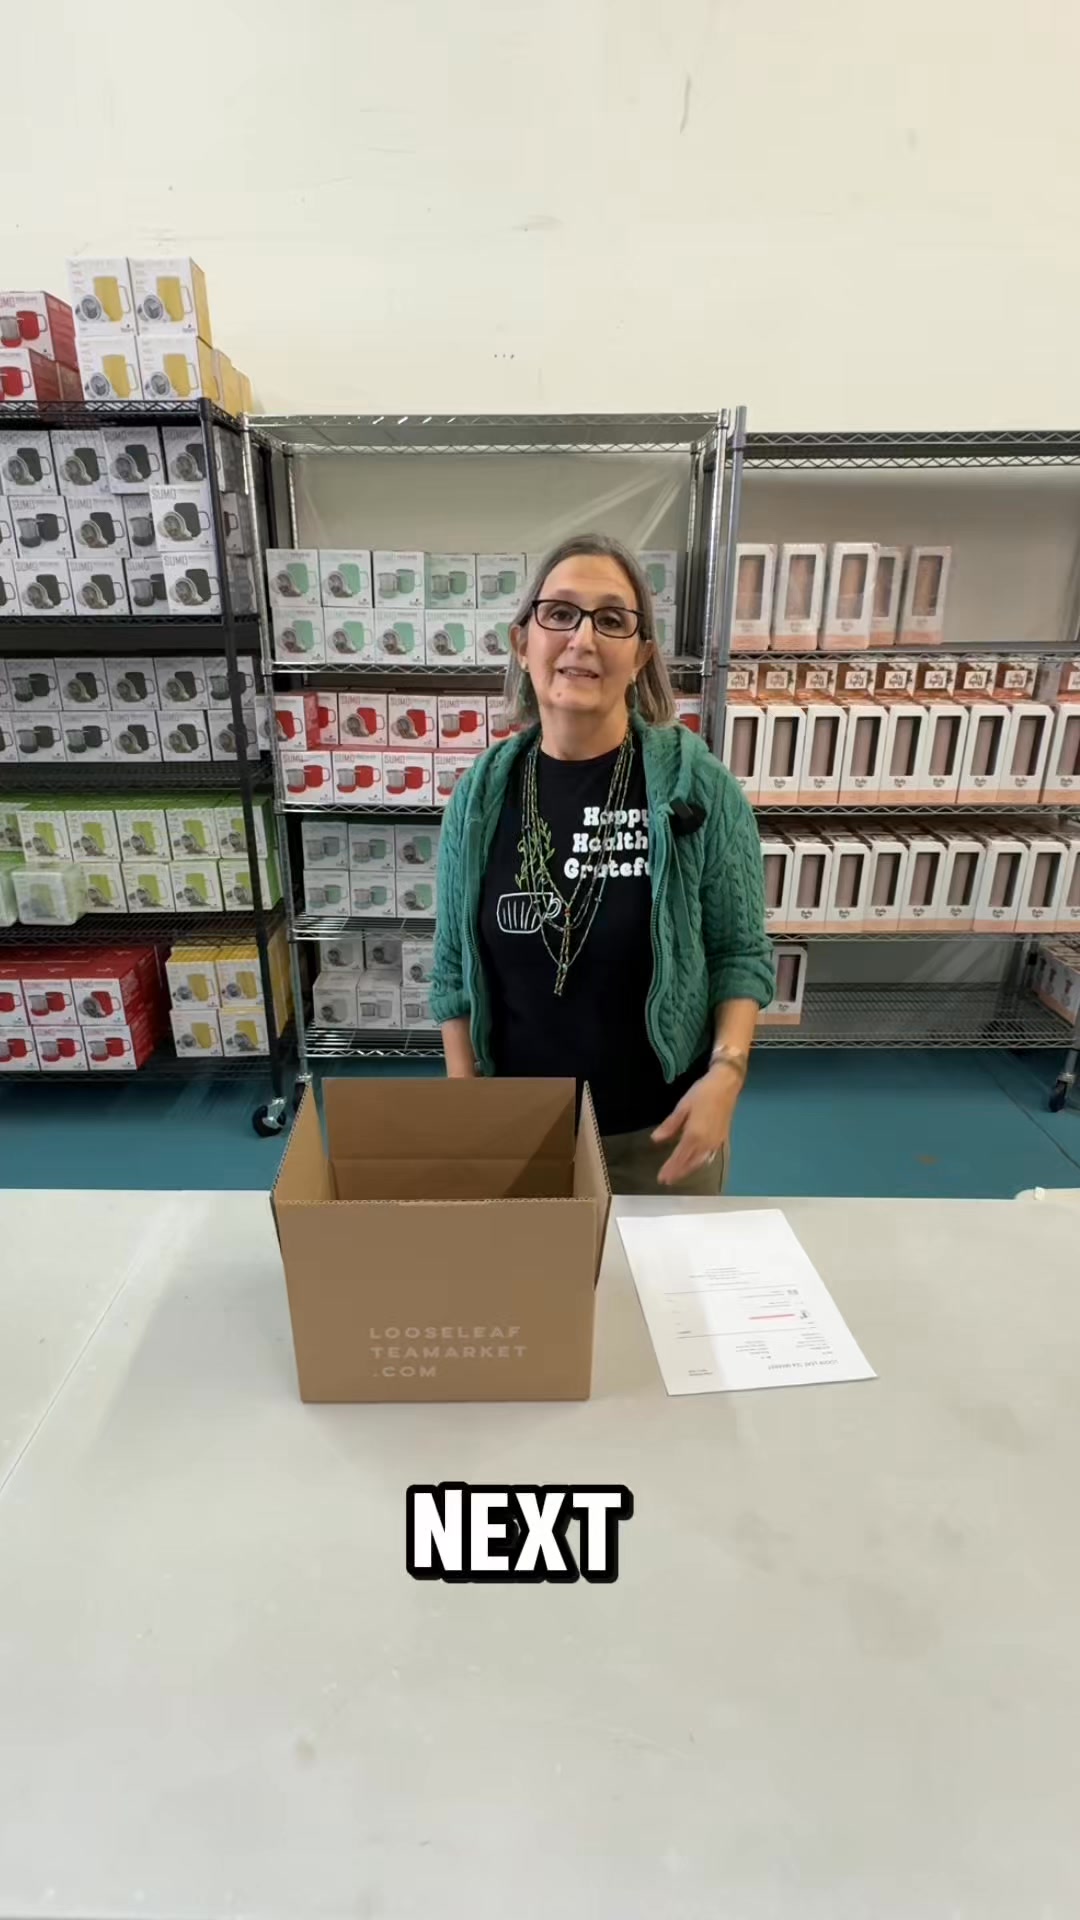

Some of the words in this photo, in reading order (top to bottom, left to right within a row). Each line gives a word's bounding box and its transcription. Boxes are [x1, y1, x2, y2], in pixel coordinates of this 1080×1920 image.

[152, 488, 176, 500] SUMO
[164, 555, 188, 566] SUMO
[369, 1326, 521, 1340] LOOSELEAF
[370, 1346, 528, 1359] TEAMARKET
[372, 1365, 437, 1378] .COM
